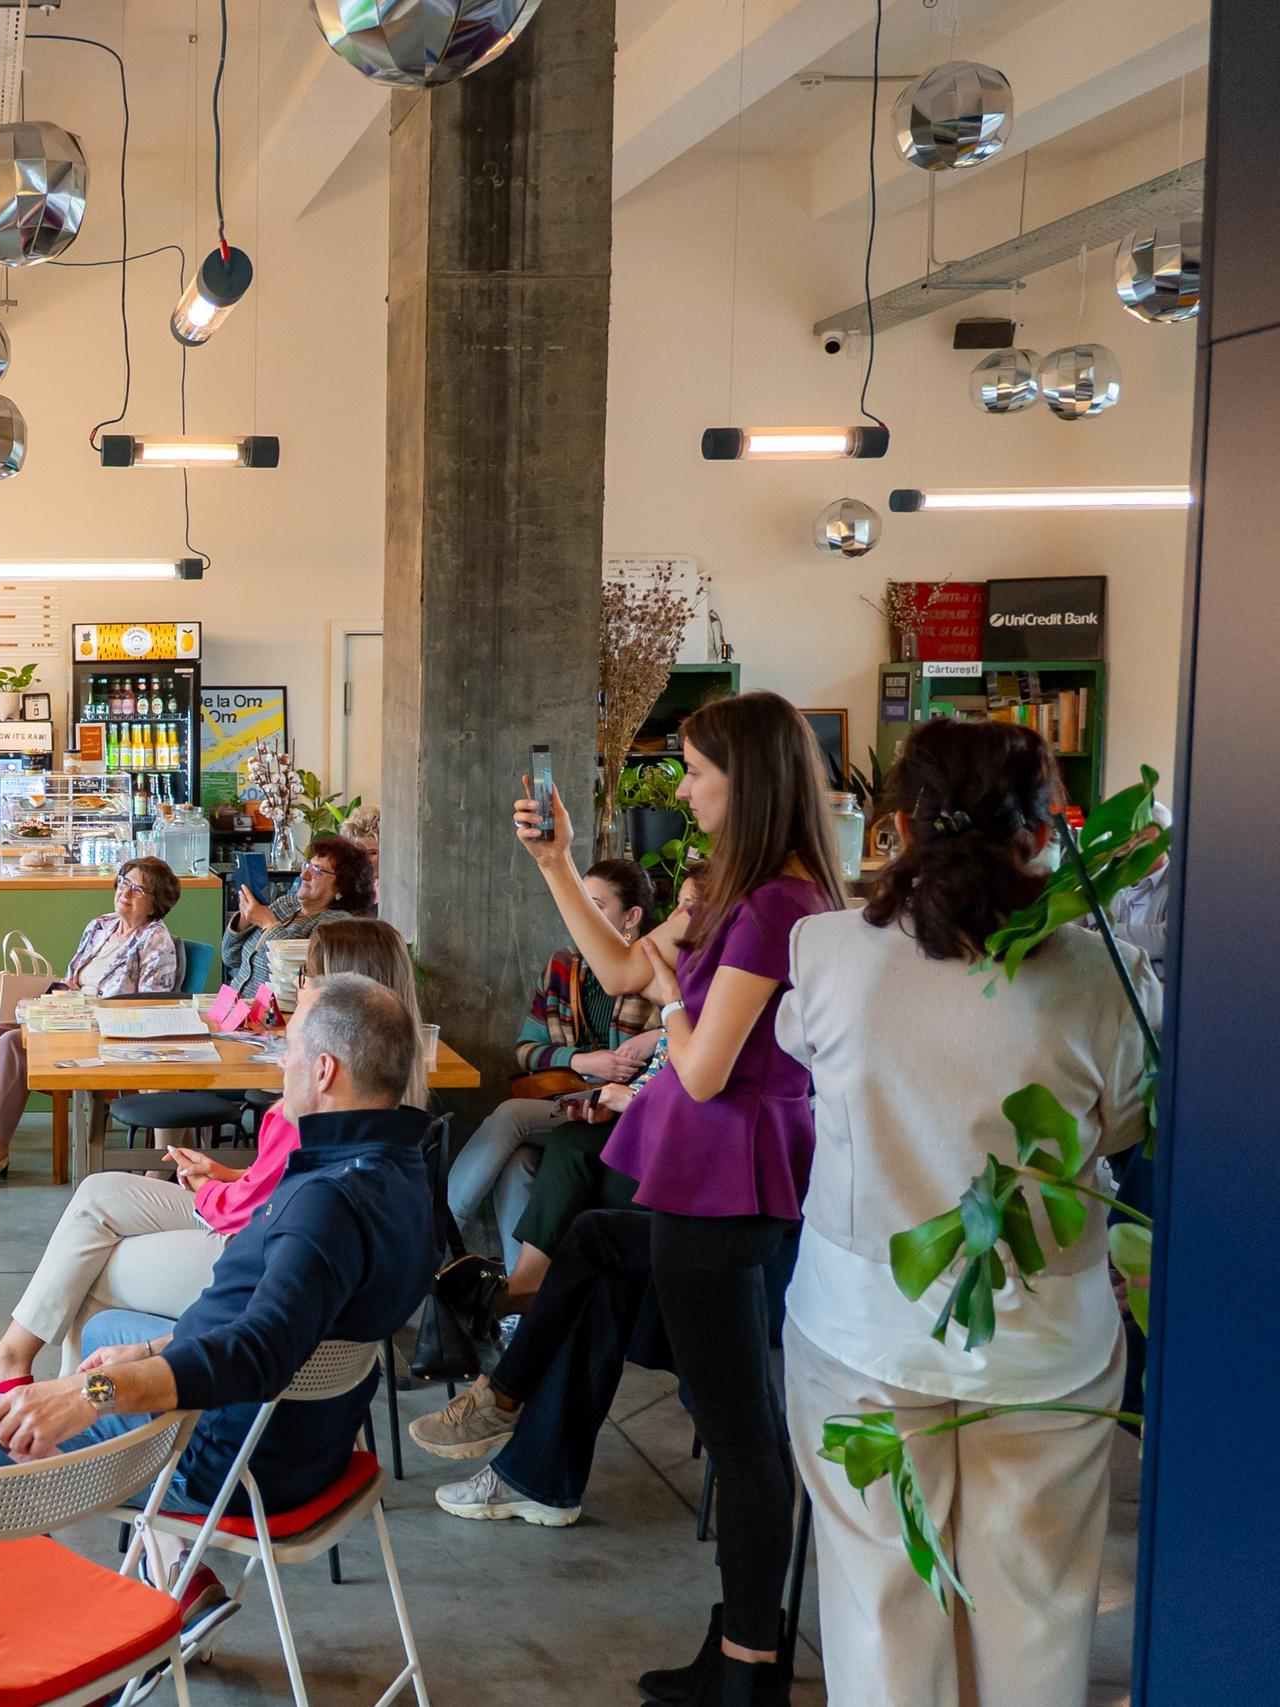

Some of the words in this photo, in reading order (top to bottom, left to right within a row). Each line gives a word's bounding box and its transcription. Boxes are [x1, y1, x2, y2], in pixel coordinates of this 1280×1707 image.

[1004, 613, 1062, 626] UniCredit
[1064, 612, 1098, 625] Bank
[927, 664, 979, 676] Cărturești
[200, 696, 213, 708] e
[217, 694, 230, 708] la
